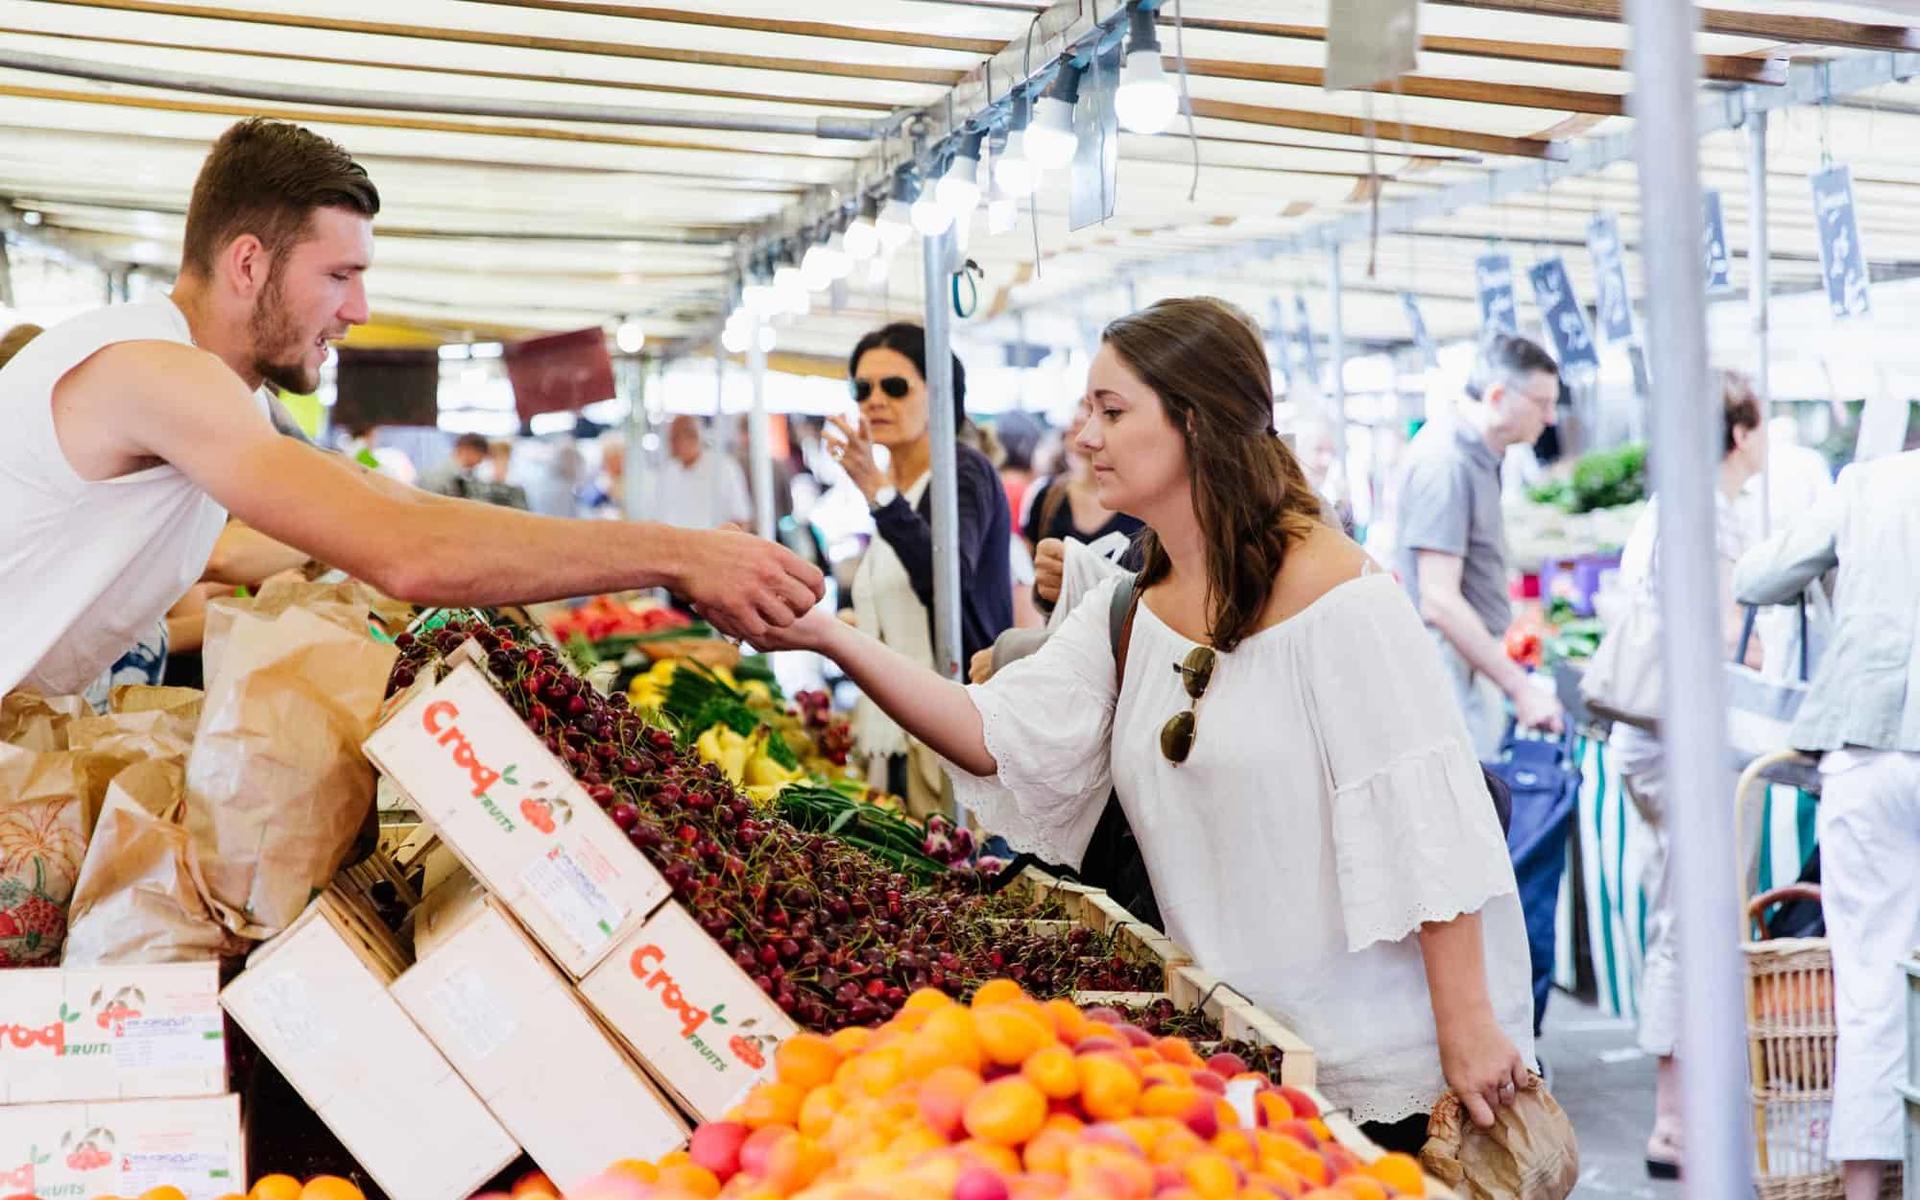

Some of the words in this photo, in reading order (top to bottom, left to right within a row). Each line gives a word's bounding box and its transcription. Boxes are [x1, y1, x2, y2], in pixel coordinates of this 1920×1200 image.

[422, 700, 500, 797] Croq
[479, 793, 516, 833] FRUITS
[630, 944, 709, 1039] Croq
[688, 1033, 728, 1072] FRUITS
